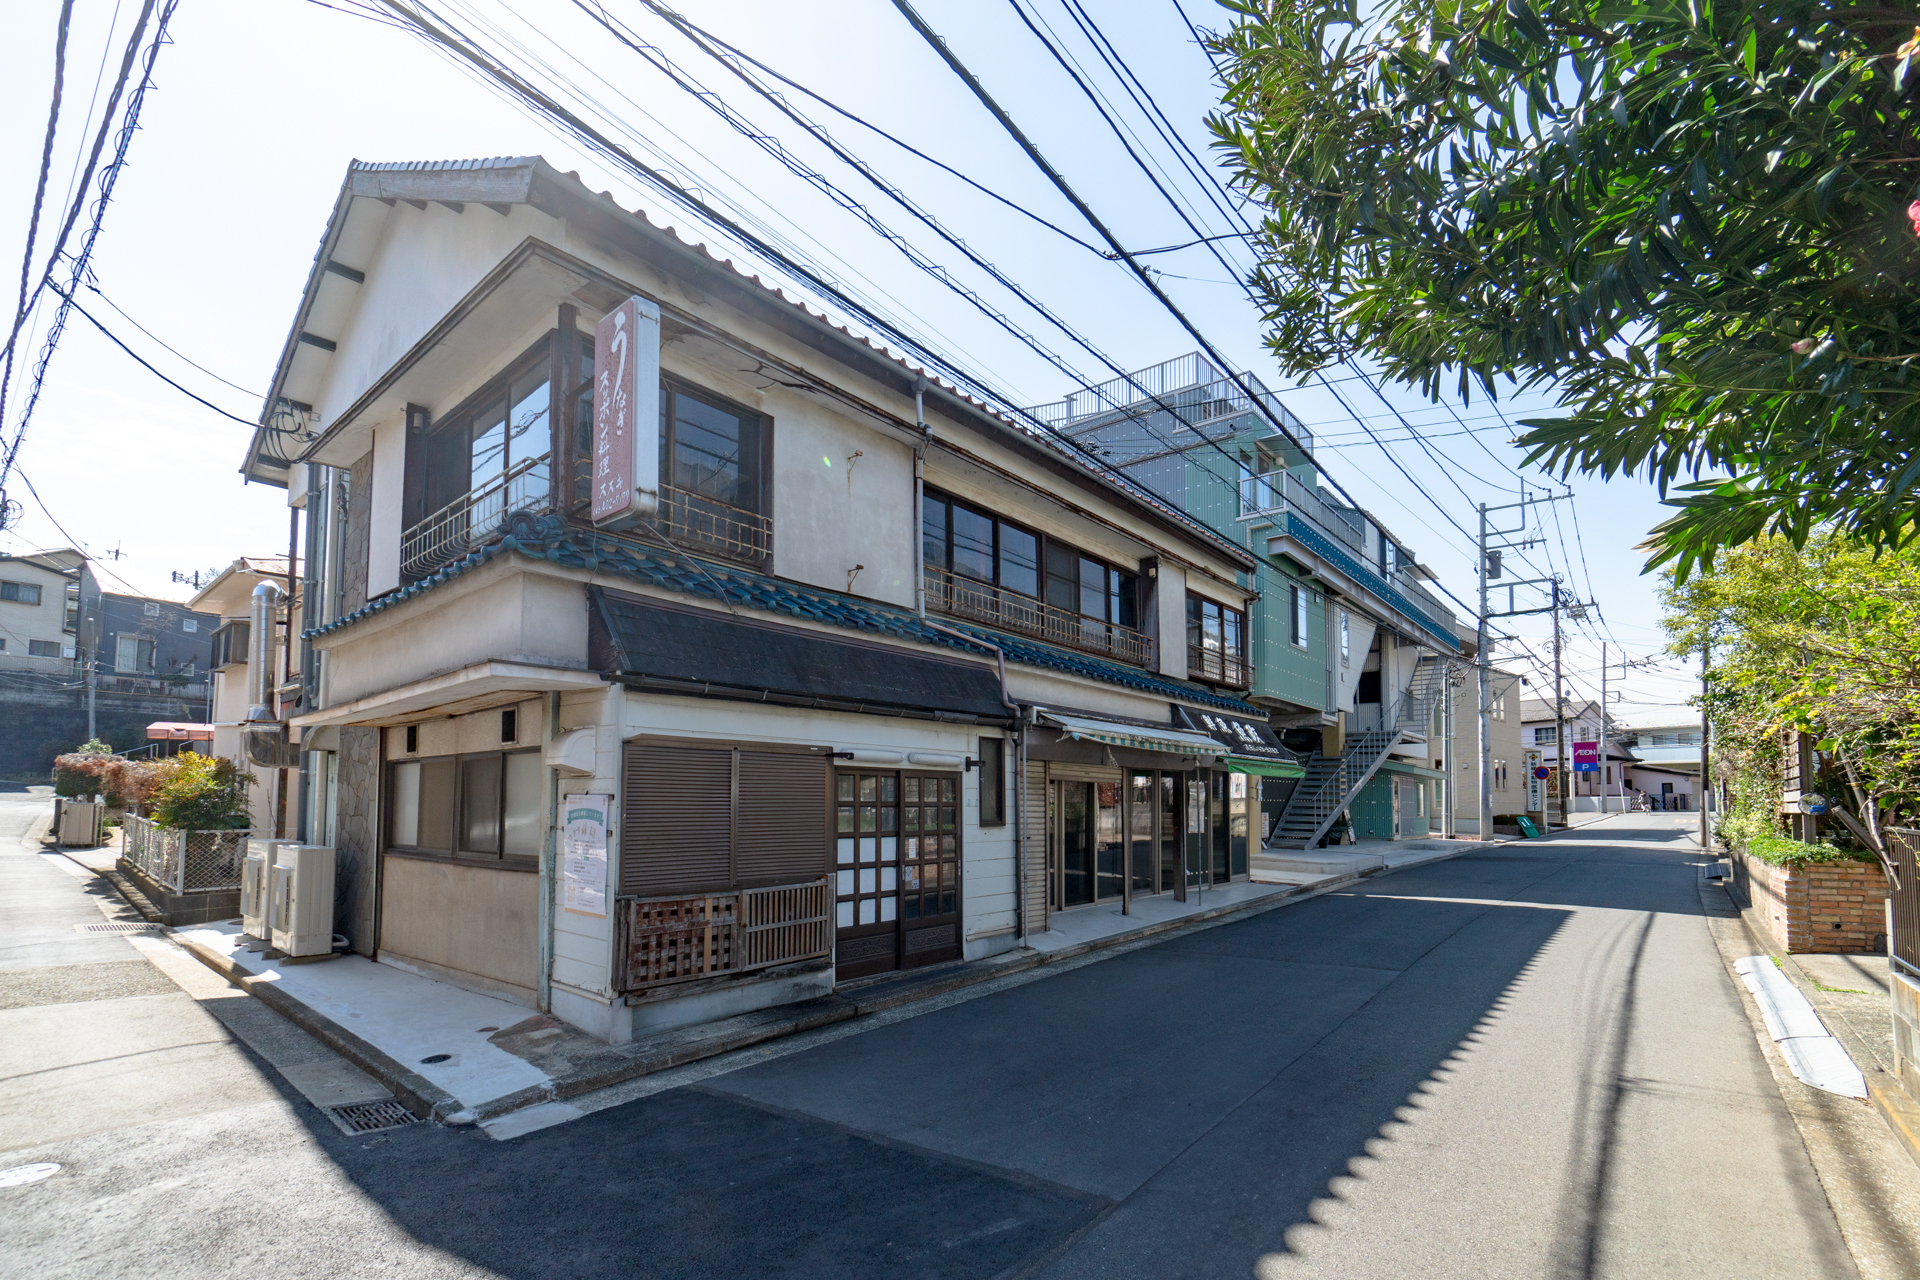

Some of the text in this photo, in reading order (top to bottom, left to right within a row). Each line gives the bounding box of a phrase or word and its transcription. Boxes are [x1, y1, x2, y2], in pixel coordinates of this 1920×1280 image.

[597, 370, 611, 480] スッポン料理
[611, 311, 628, 436] うなぎ
[598, 473, 624, 500] スズキ
